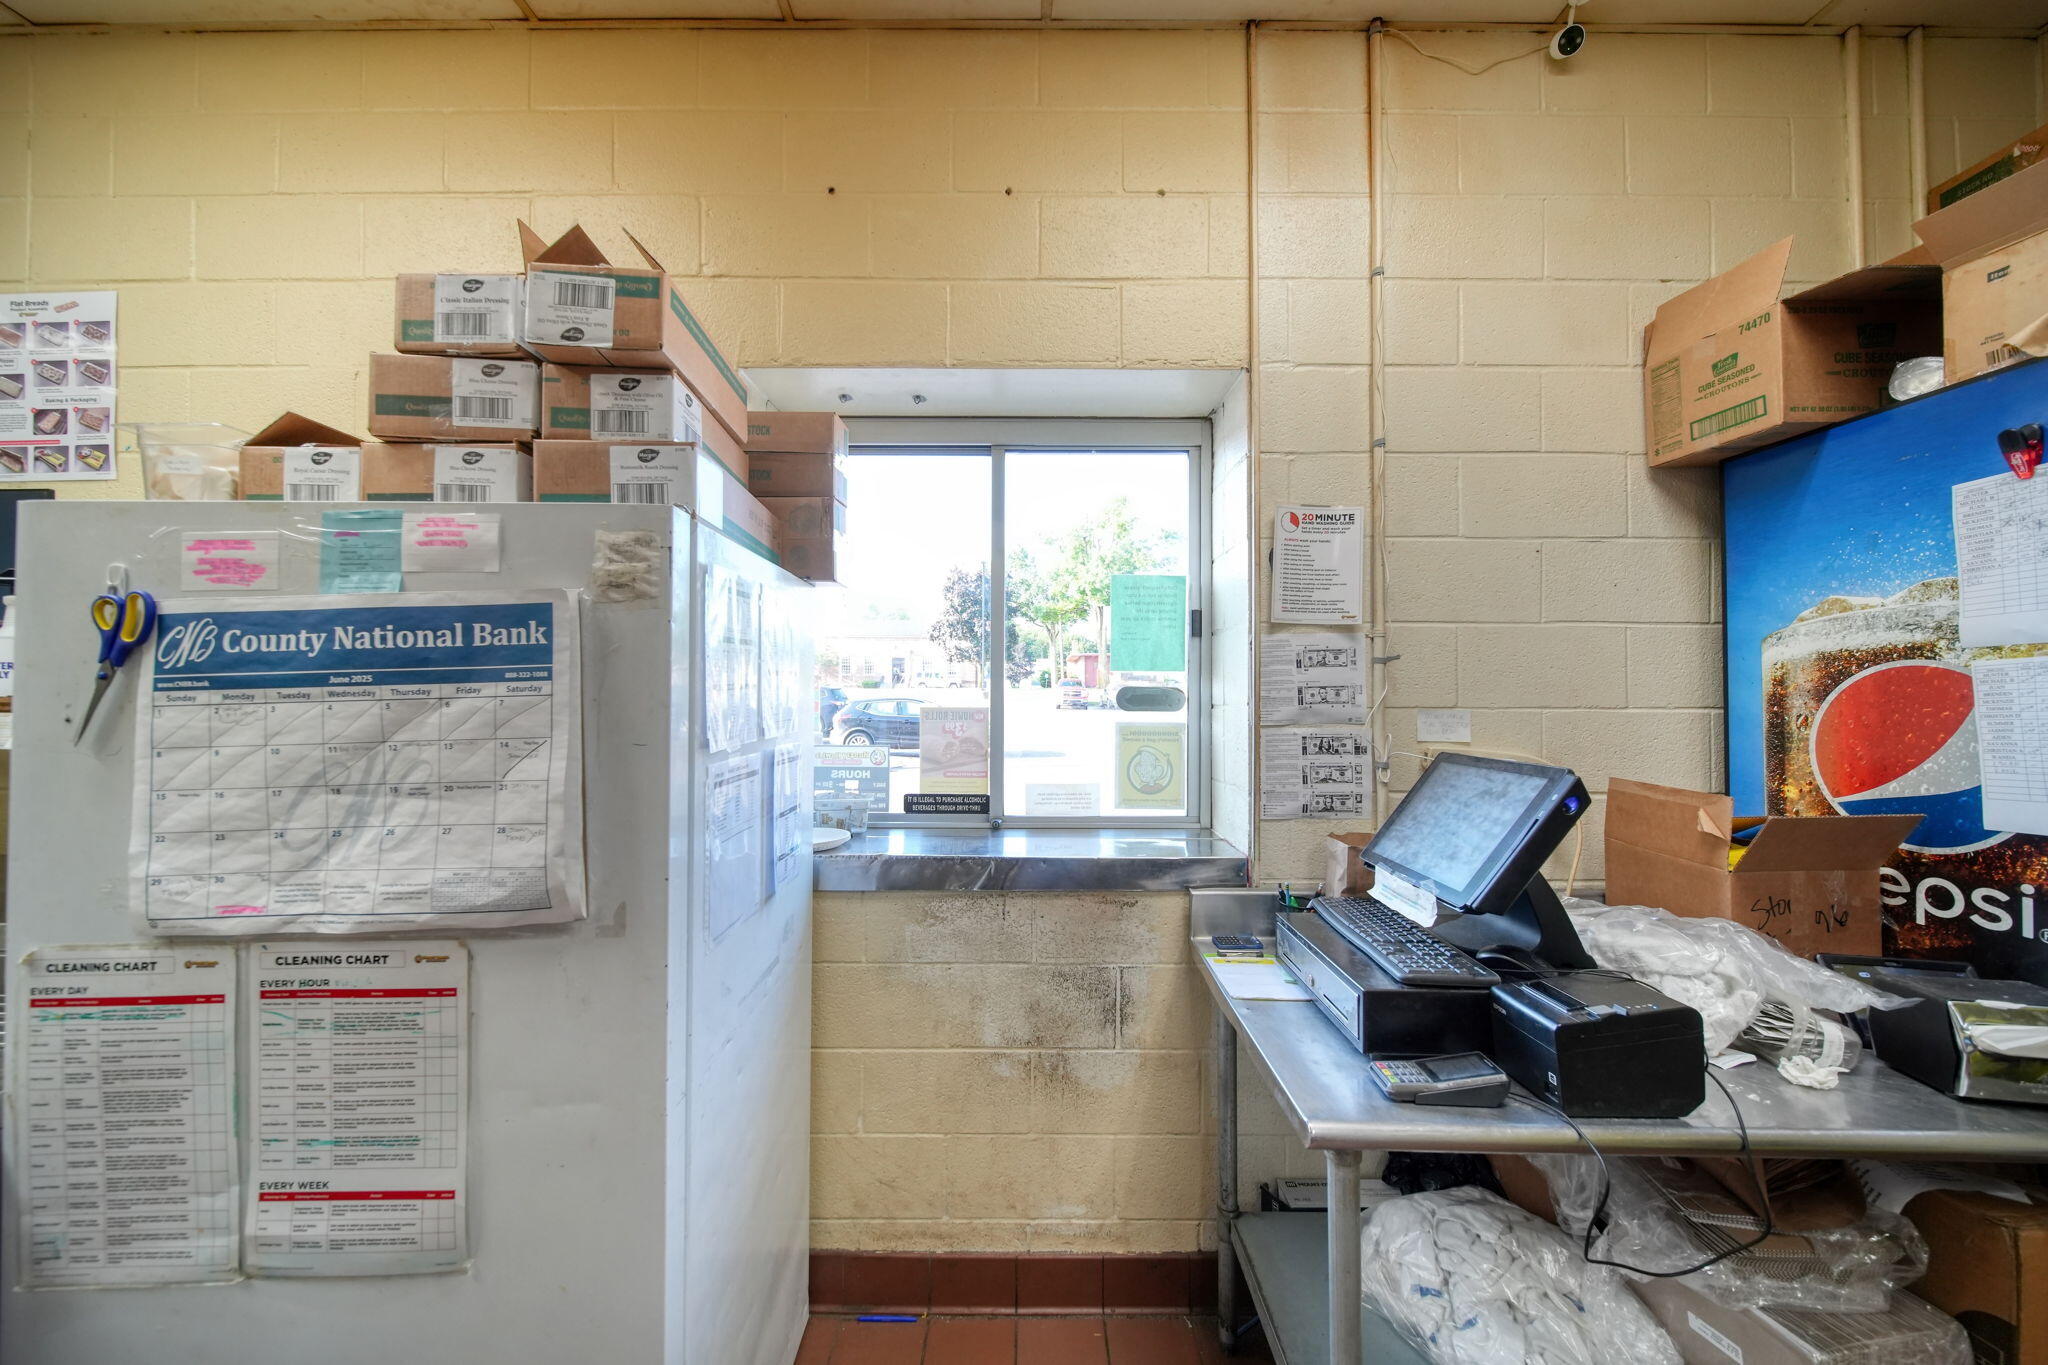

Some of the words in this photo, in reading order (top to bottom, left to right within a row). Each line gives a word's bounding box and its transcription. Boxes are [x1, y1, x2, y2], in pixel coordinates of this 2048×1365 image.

[1738, 312, 1771, 335] 74470
[1834, 352, 1862, 363] CUBE
[1698, 380, 1716, 393] CUBE
[1717, 363, 1755, 386] SEASONED
[1704, 377, 1750, 400] CROUTONS
[748, 425, 771, 435] STOCK
[1302, 513, 1314, 521] 20
[222, 629, 328, 657] County
[333, 622, 464, 650] National
[472, 620, 548, 647] Bank
[351, 675, 373, 683] 2025
[222, 693, 255, 701] Monday
[277, 692, 311, 700] Tuesday
[327, 689, 376, 698] Wednesday
[390, 688, 431, 697] Thursday
[456, 687, 482, 695] Friday
[506, 685, 543, 693] Saturday
[1880, 866, 2035, 939] epsi
[275, 955, 343, 966] CLEANING
[346, 955, 389, 965] CHART
[46, 962, 110, 974] CLEANING
[113, 961, 158, 972] CHART
[260, 979, 295, 988] EVERY
[299, 979, 330, 987] HOUR
[30, 987, 65, 996] EVERY
[68, 986, 89, 995] DAY
[259, 1182, 295, 1190] EVERY
[297, 1181, 329, 1190] WEEK
